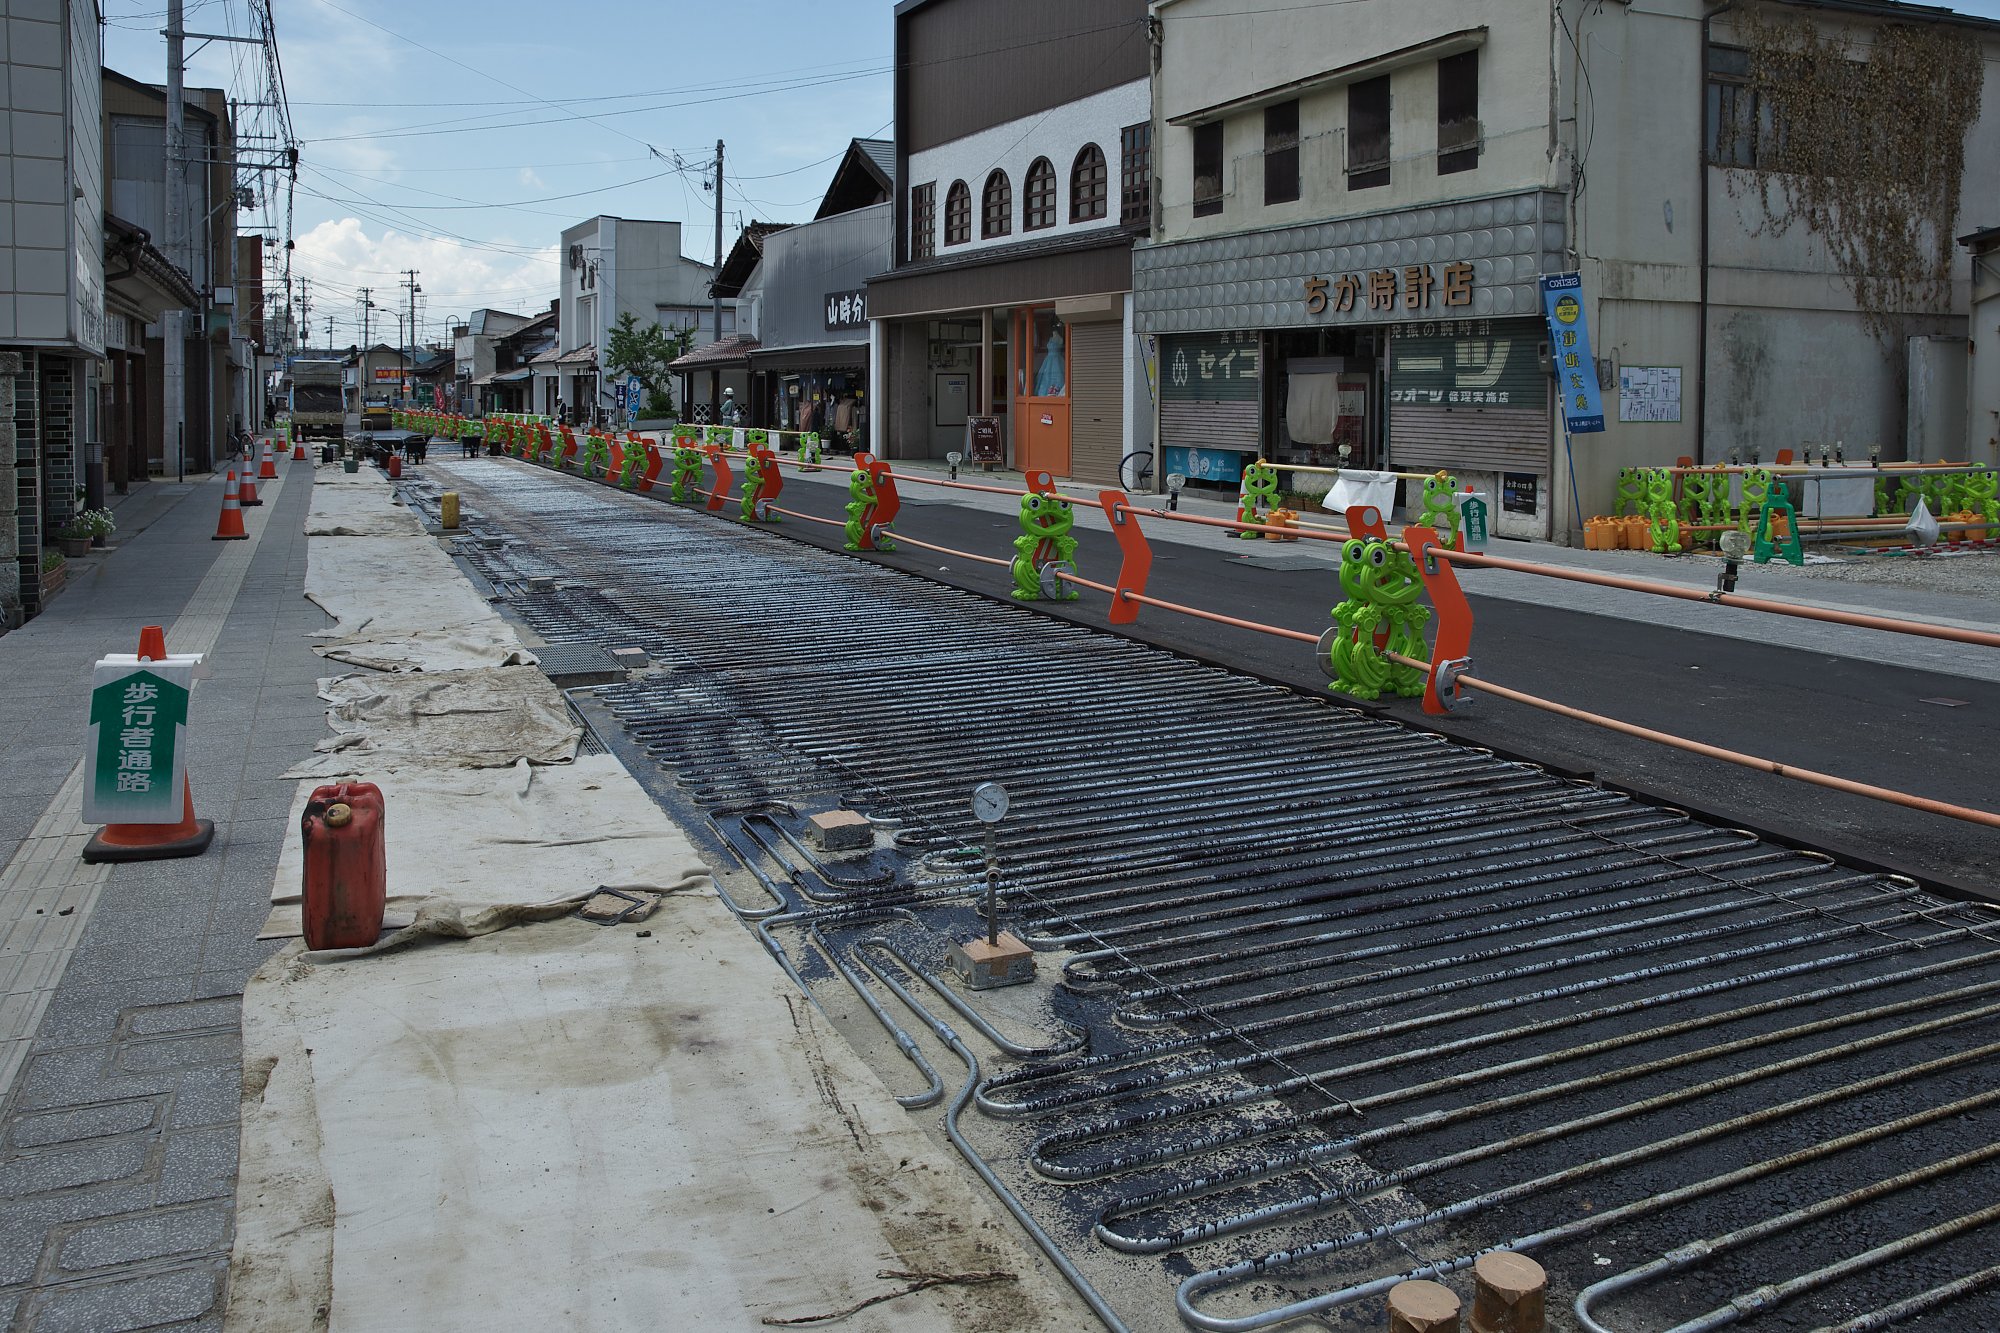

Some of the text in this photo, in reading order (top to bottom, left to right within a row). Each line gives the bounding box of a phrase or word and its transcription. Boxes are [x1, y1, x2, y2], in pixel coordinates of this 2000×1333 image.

[1304, 262, 1473, 314] ちか時計店
[828, 293, 868, 325] 山時分
[1448, 390, 1510, 403] 修理実施店
[1506, 480, 1533, 491] 会津の四季
[1469, 501, 1481, 541] 歩行者通路
[115, 682, 159, 794] 歩行者通路
